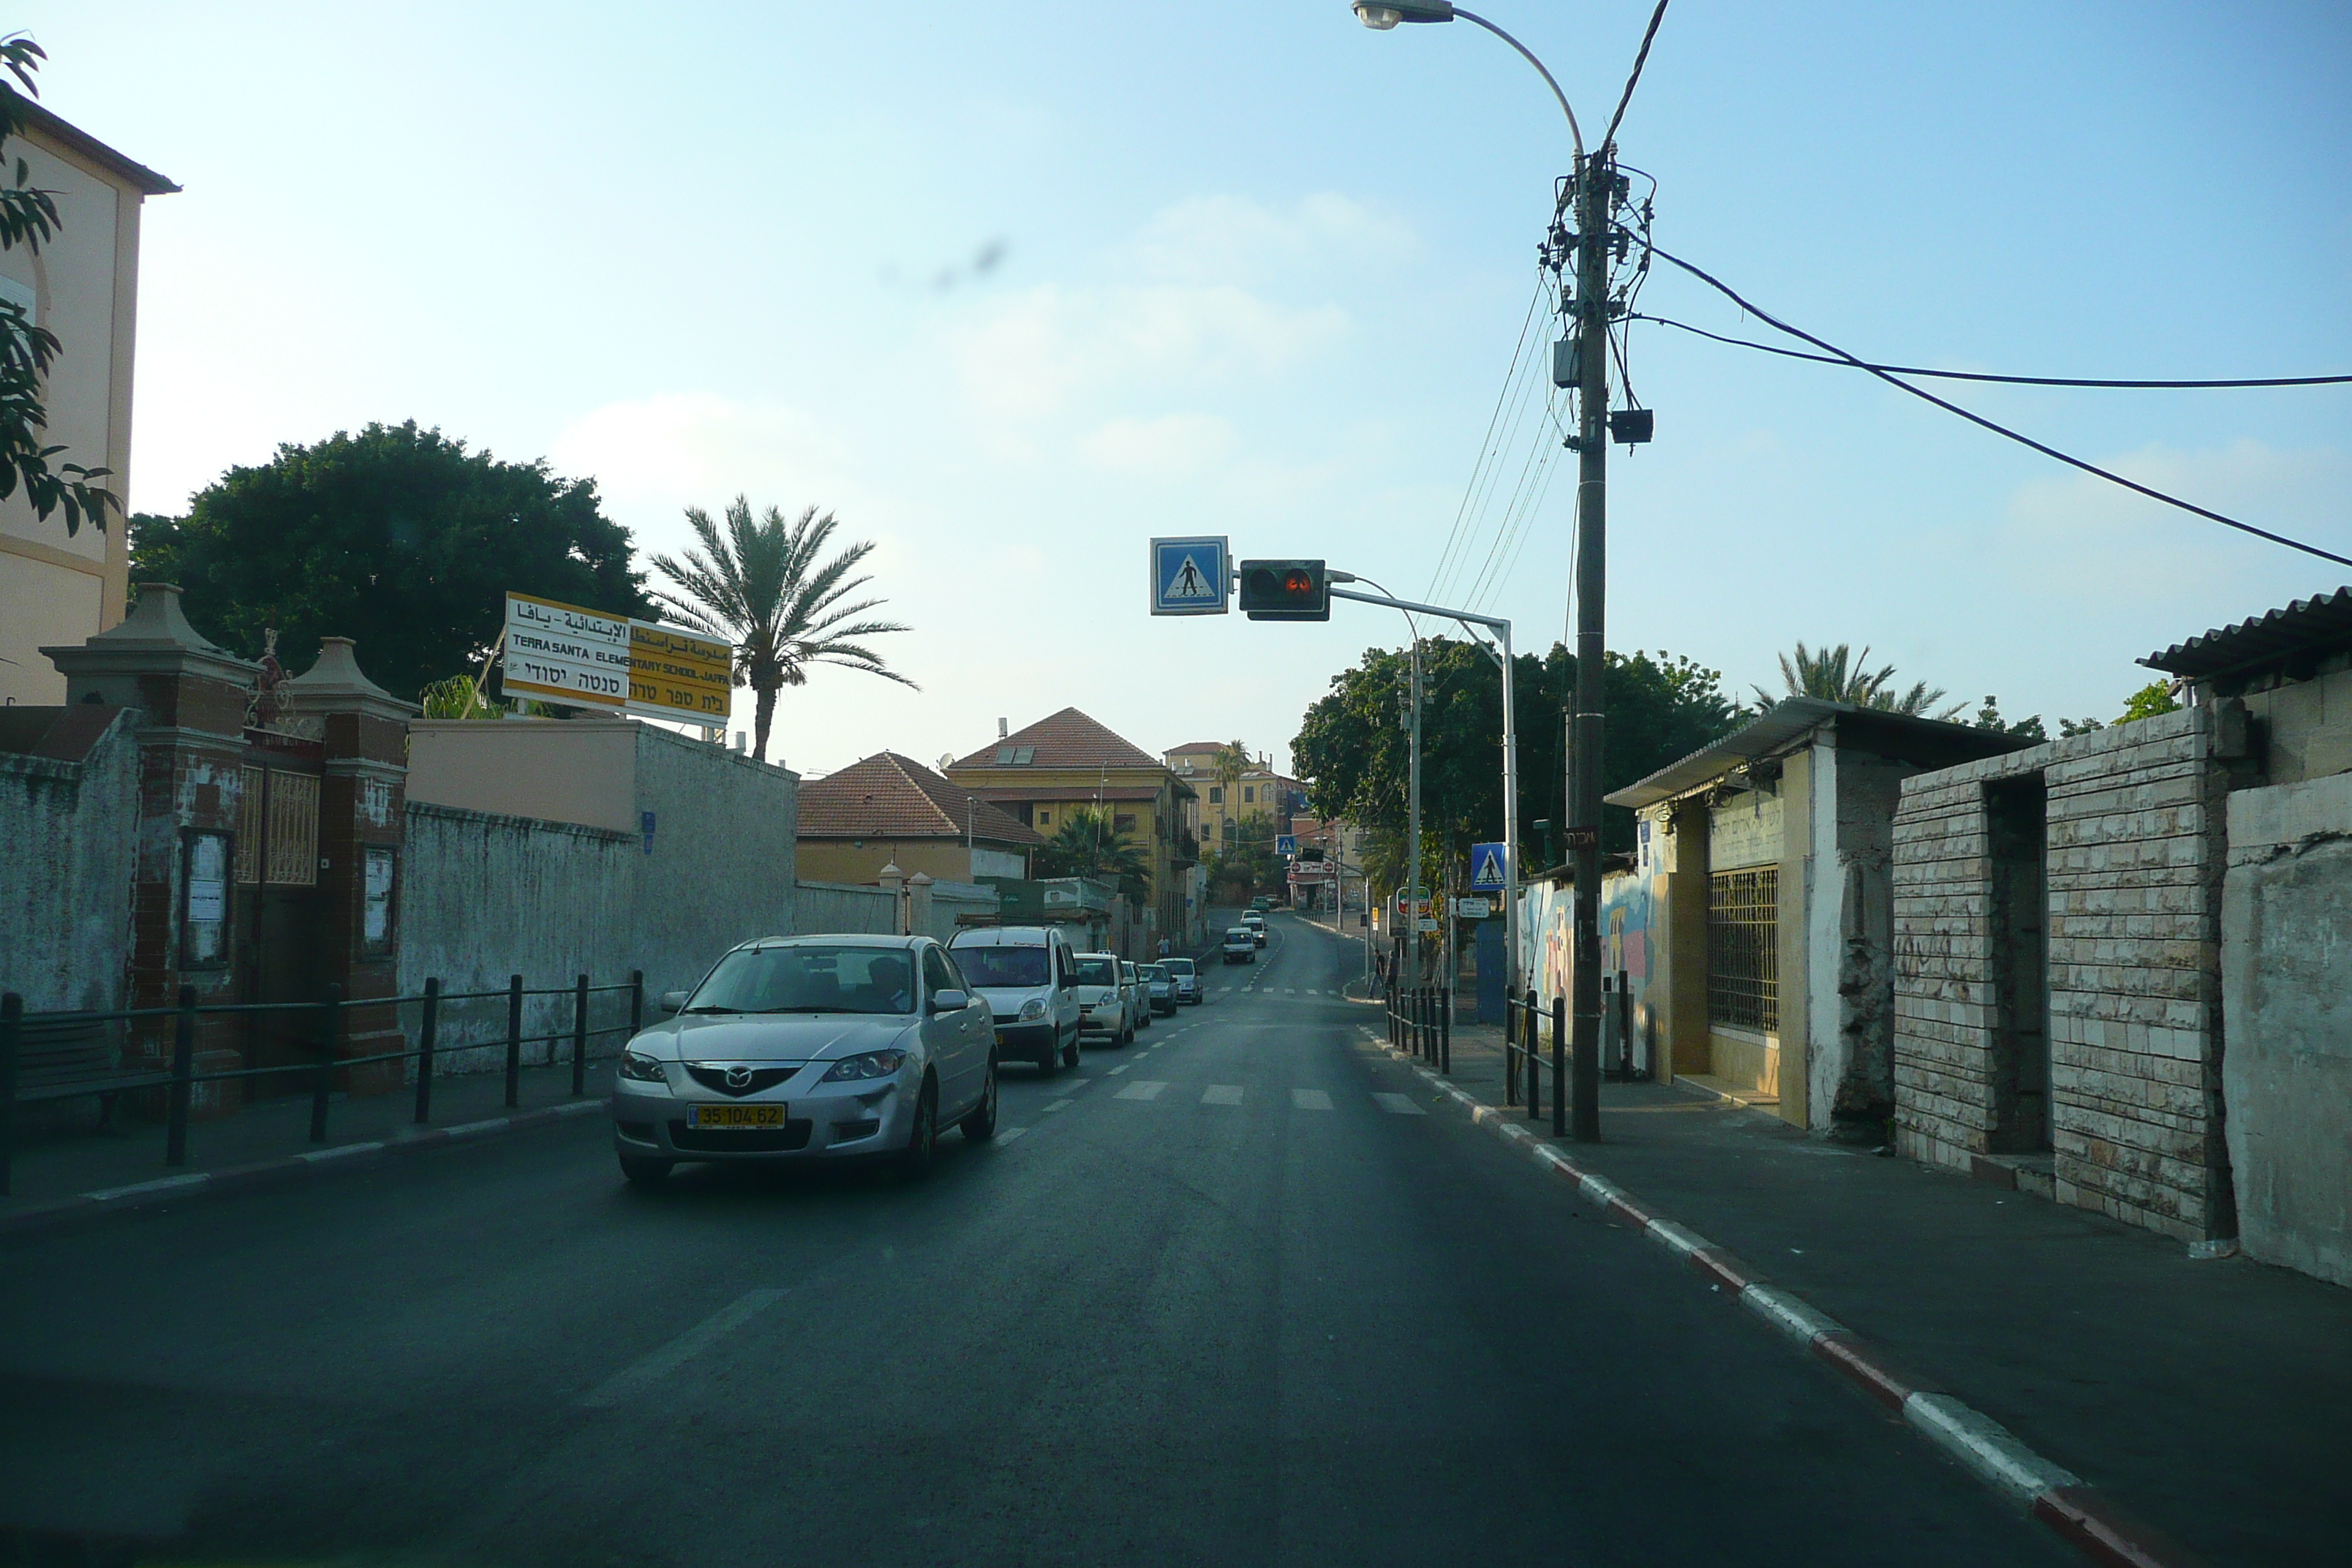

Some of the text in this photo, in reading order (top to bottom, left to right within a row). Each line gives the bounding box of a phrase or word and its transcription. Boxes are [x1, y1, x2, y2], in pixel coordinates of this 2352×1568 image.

[518, 603, 551, 628] يافا
[513, 634, 551, 652] TERRA
[552, 643, 589, 659] SANTA
[596, 652, 662, 671] ELEMENTARY
[524, 663, 567, 683] יסודי
[578, 673, 619, 693] סנטה
[629, 681, 657, 700] טרה
[666, 688, 693, 706] ספר
[702, 695, 723, 712] בית
[703, 1108, 777, 1123] 35 104 62
